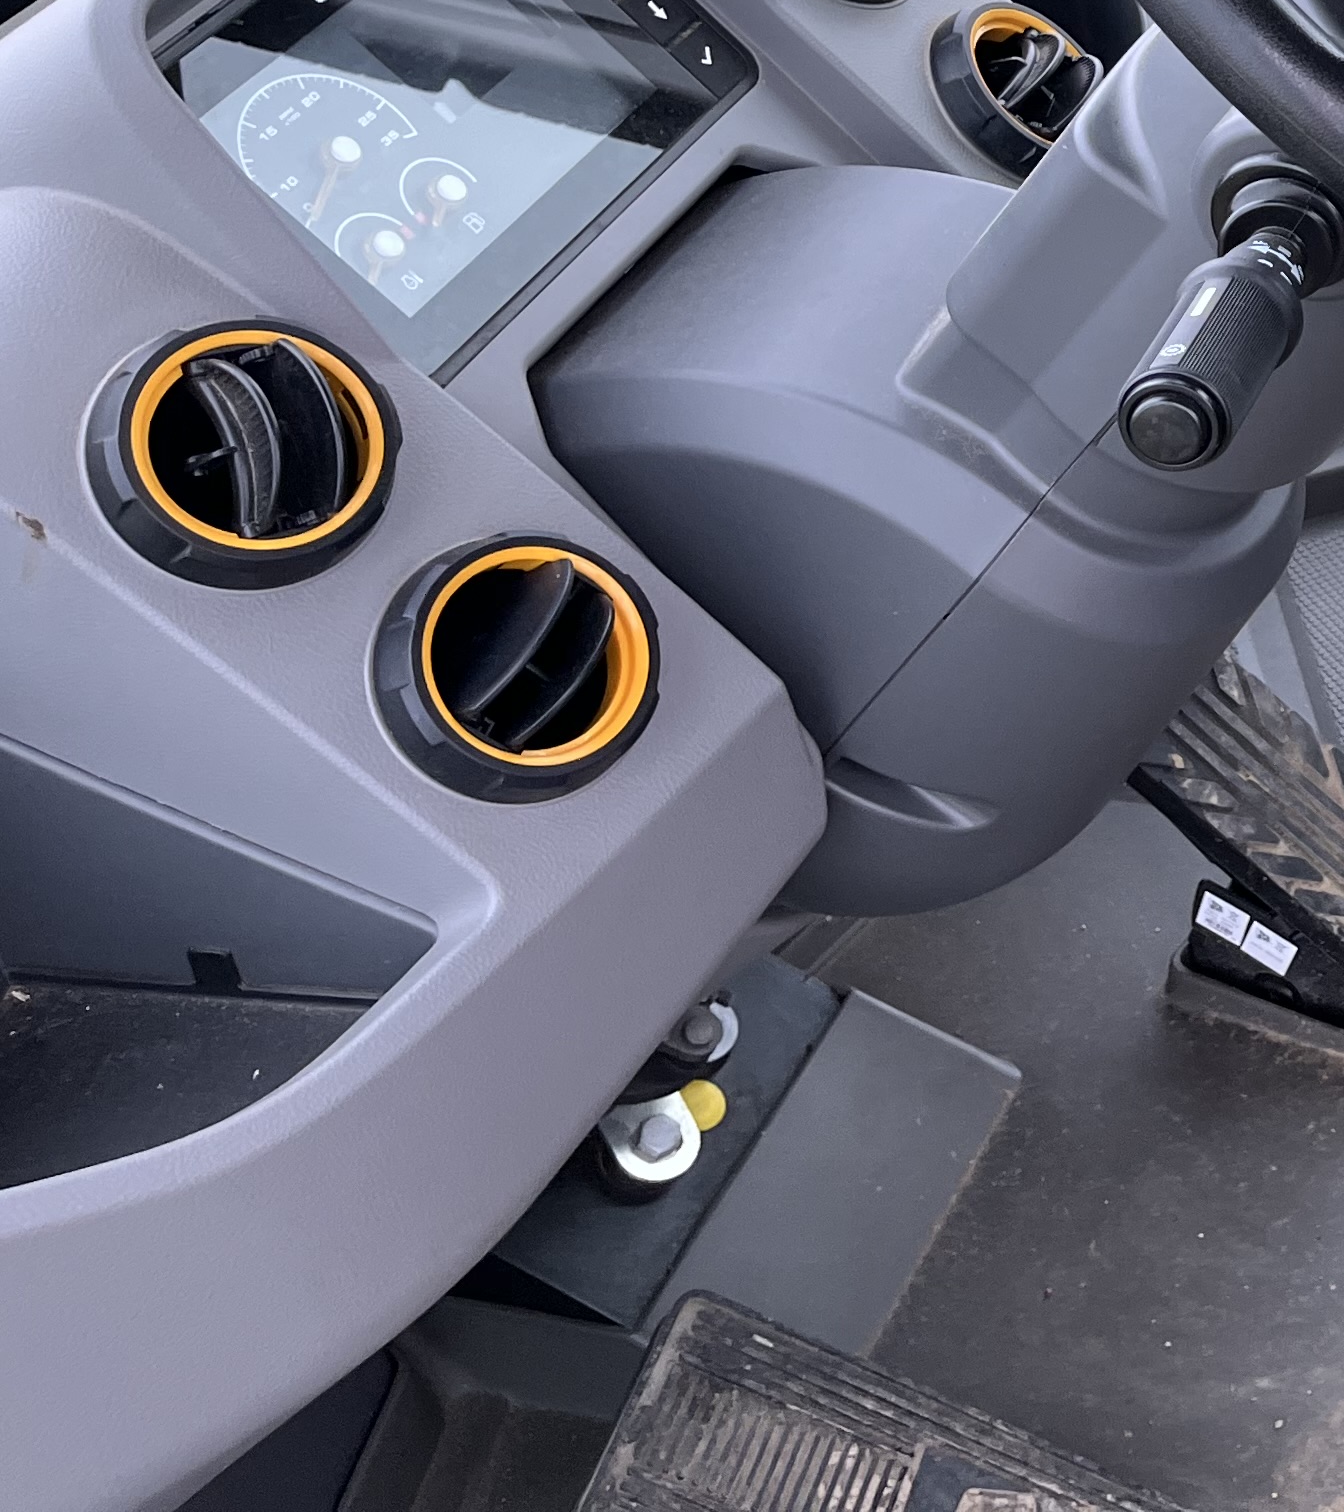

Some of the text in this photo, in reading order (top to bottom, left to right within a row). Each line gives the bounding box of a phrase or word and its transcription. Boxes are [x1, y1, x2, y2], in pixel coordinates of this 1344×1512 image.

[301, 90, 321, 108] 20
[357, 110, 378, 128] 25
[259, 125, 279, 141] 15
[380, 129, 400, 147] 35
[280, 175, 299, 191] 10
